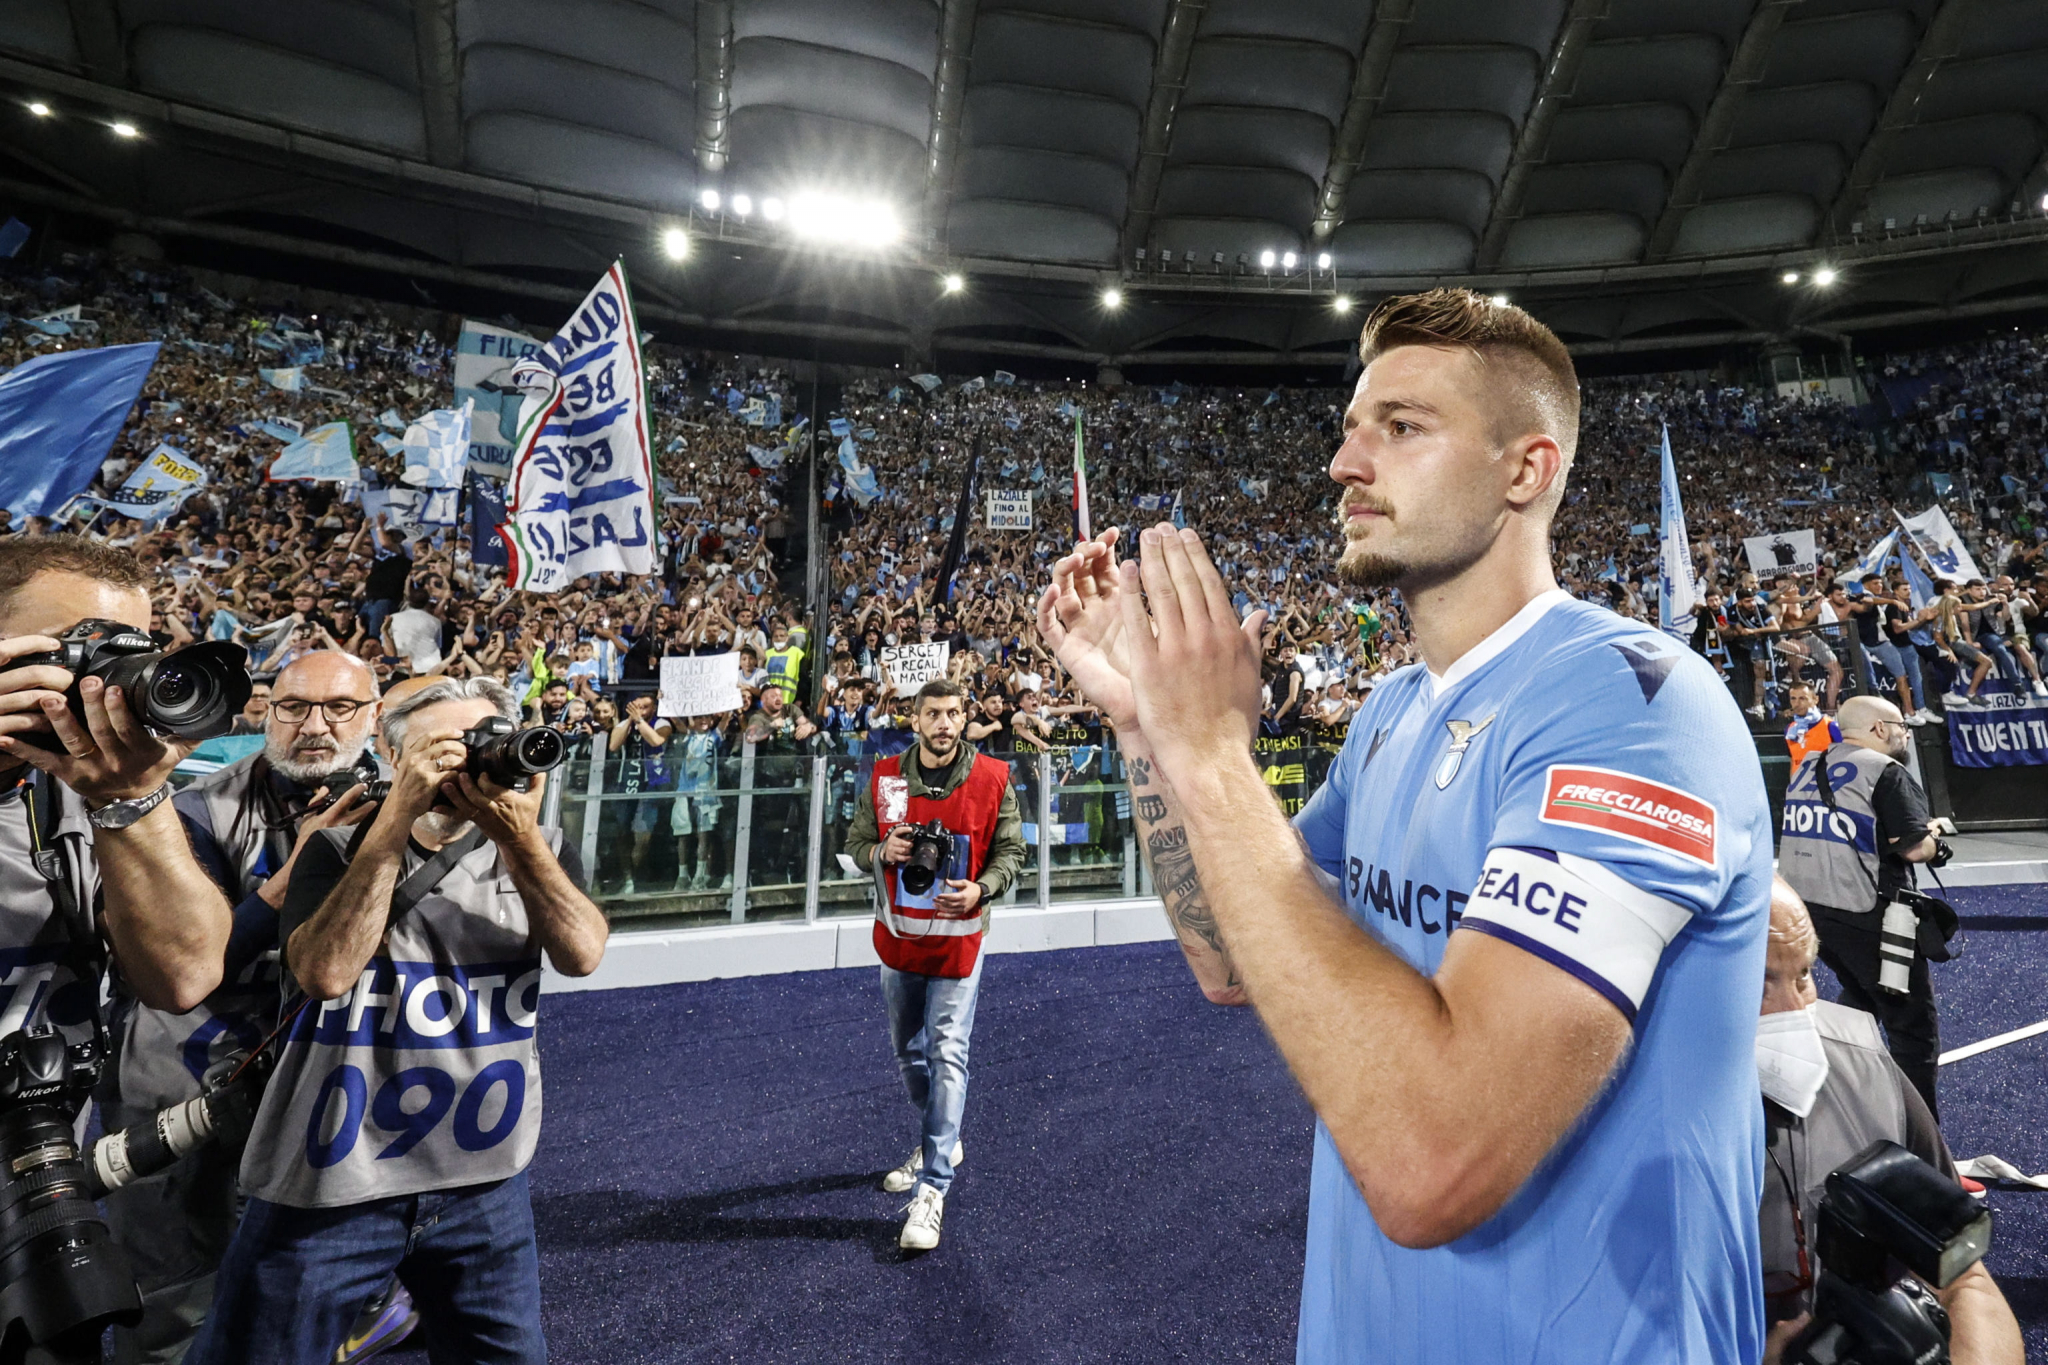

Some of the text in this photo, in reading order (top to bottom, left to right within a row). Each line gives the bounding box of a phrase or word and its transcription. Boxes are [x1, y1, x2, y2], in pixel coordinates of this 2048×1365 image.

[991, 490, 1028, 501] LAZIALE
[994, 504, 1029, 512] FINO AL
[991, 515, 1030, 526] MIDOLLO
[116, 636, 151, 647] Nikon
[1557, 784, 1713, 839] FRECCIAROSSA
[1478, 867, 1588, 934] EACE
[18, 1085, 61, 1099] Nikon
[306, 1058, 526, 1169] 090
